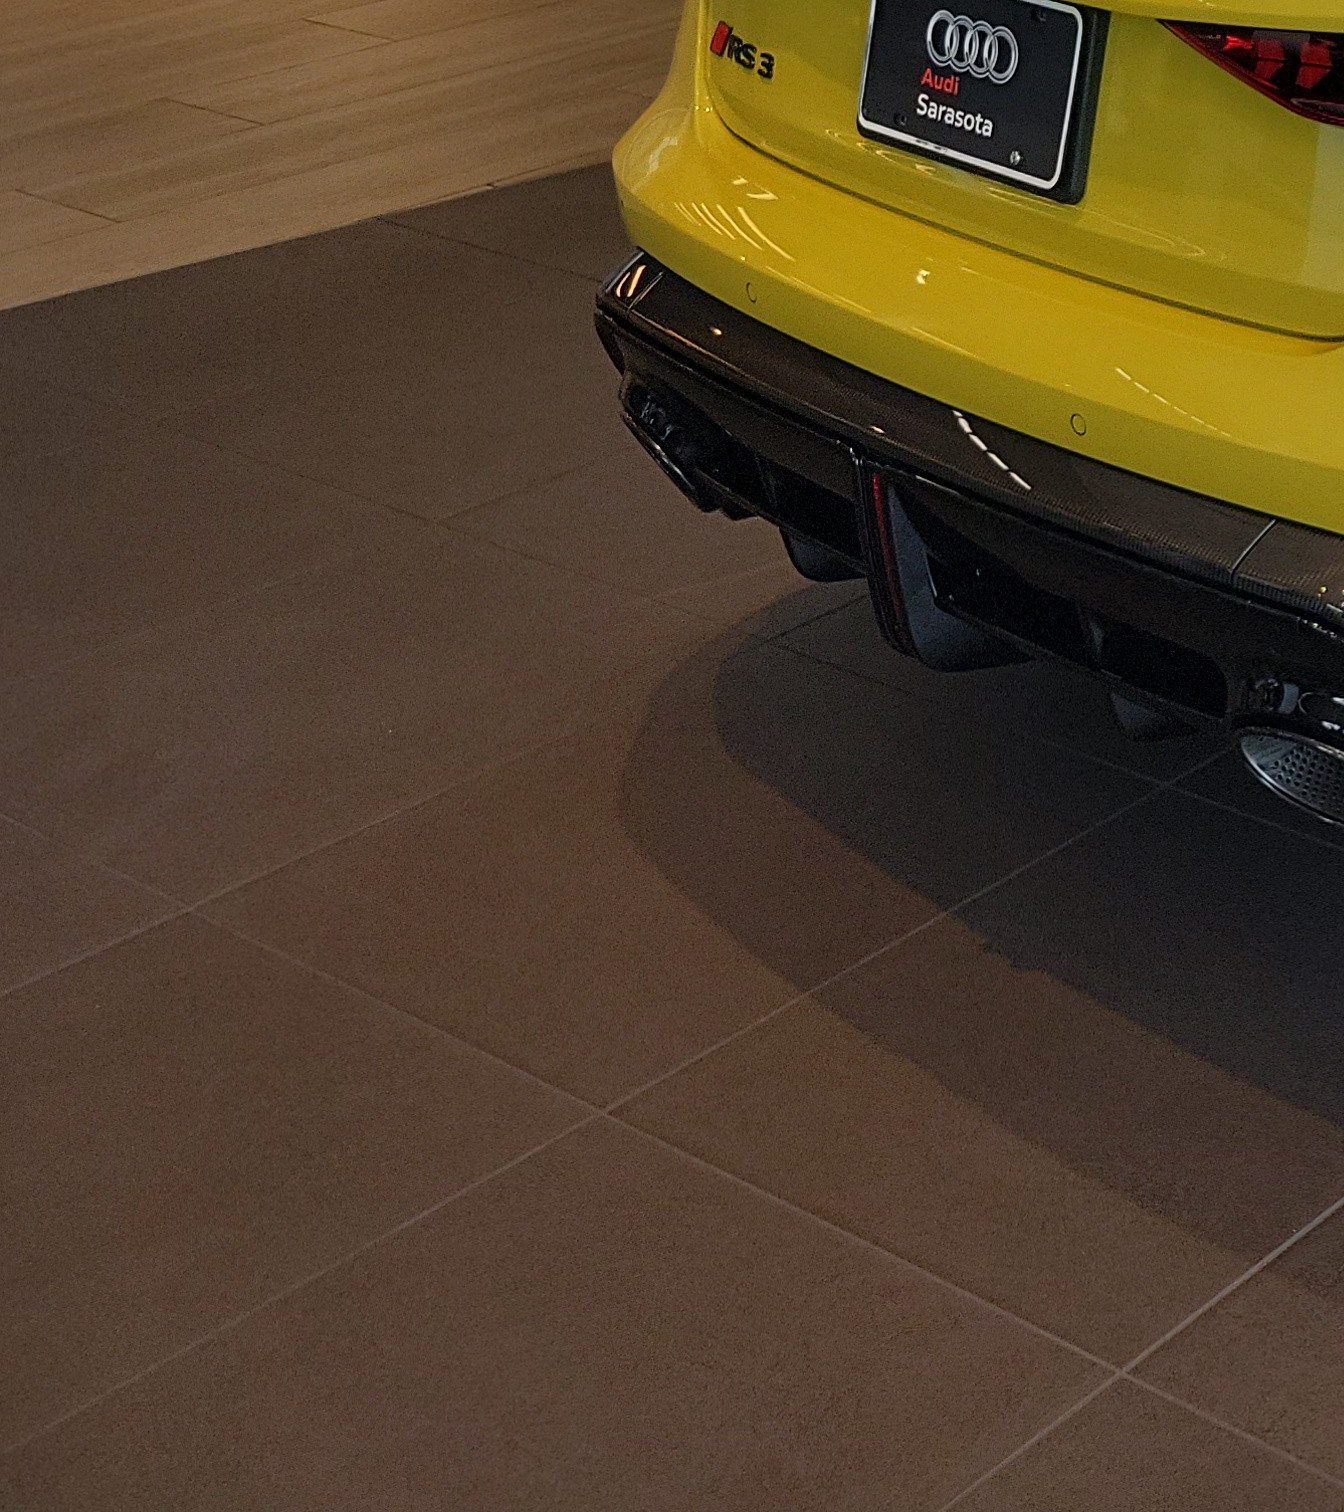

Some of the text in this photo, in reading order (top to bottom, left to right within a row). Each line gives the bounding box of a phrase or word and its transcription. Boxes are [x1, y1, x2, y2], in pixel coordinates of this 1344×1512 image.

[757, 52, 775, 79] 3
[921, 67, 960, 95] Audi
[916, 93, 993, 137] Sarasota
